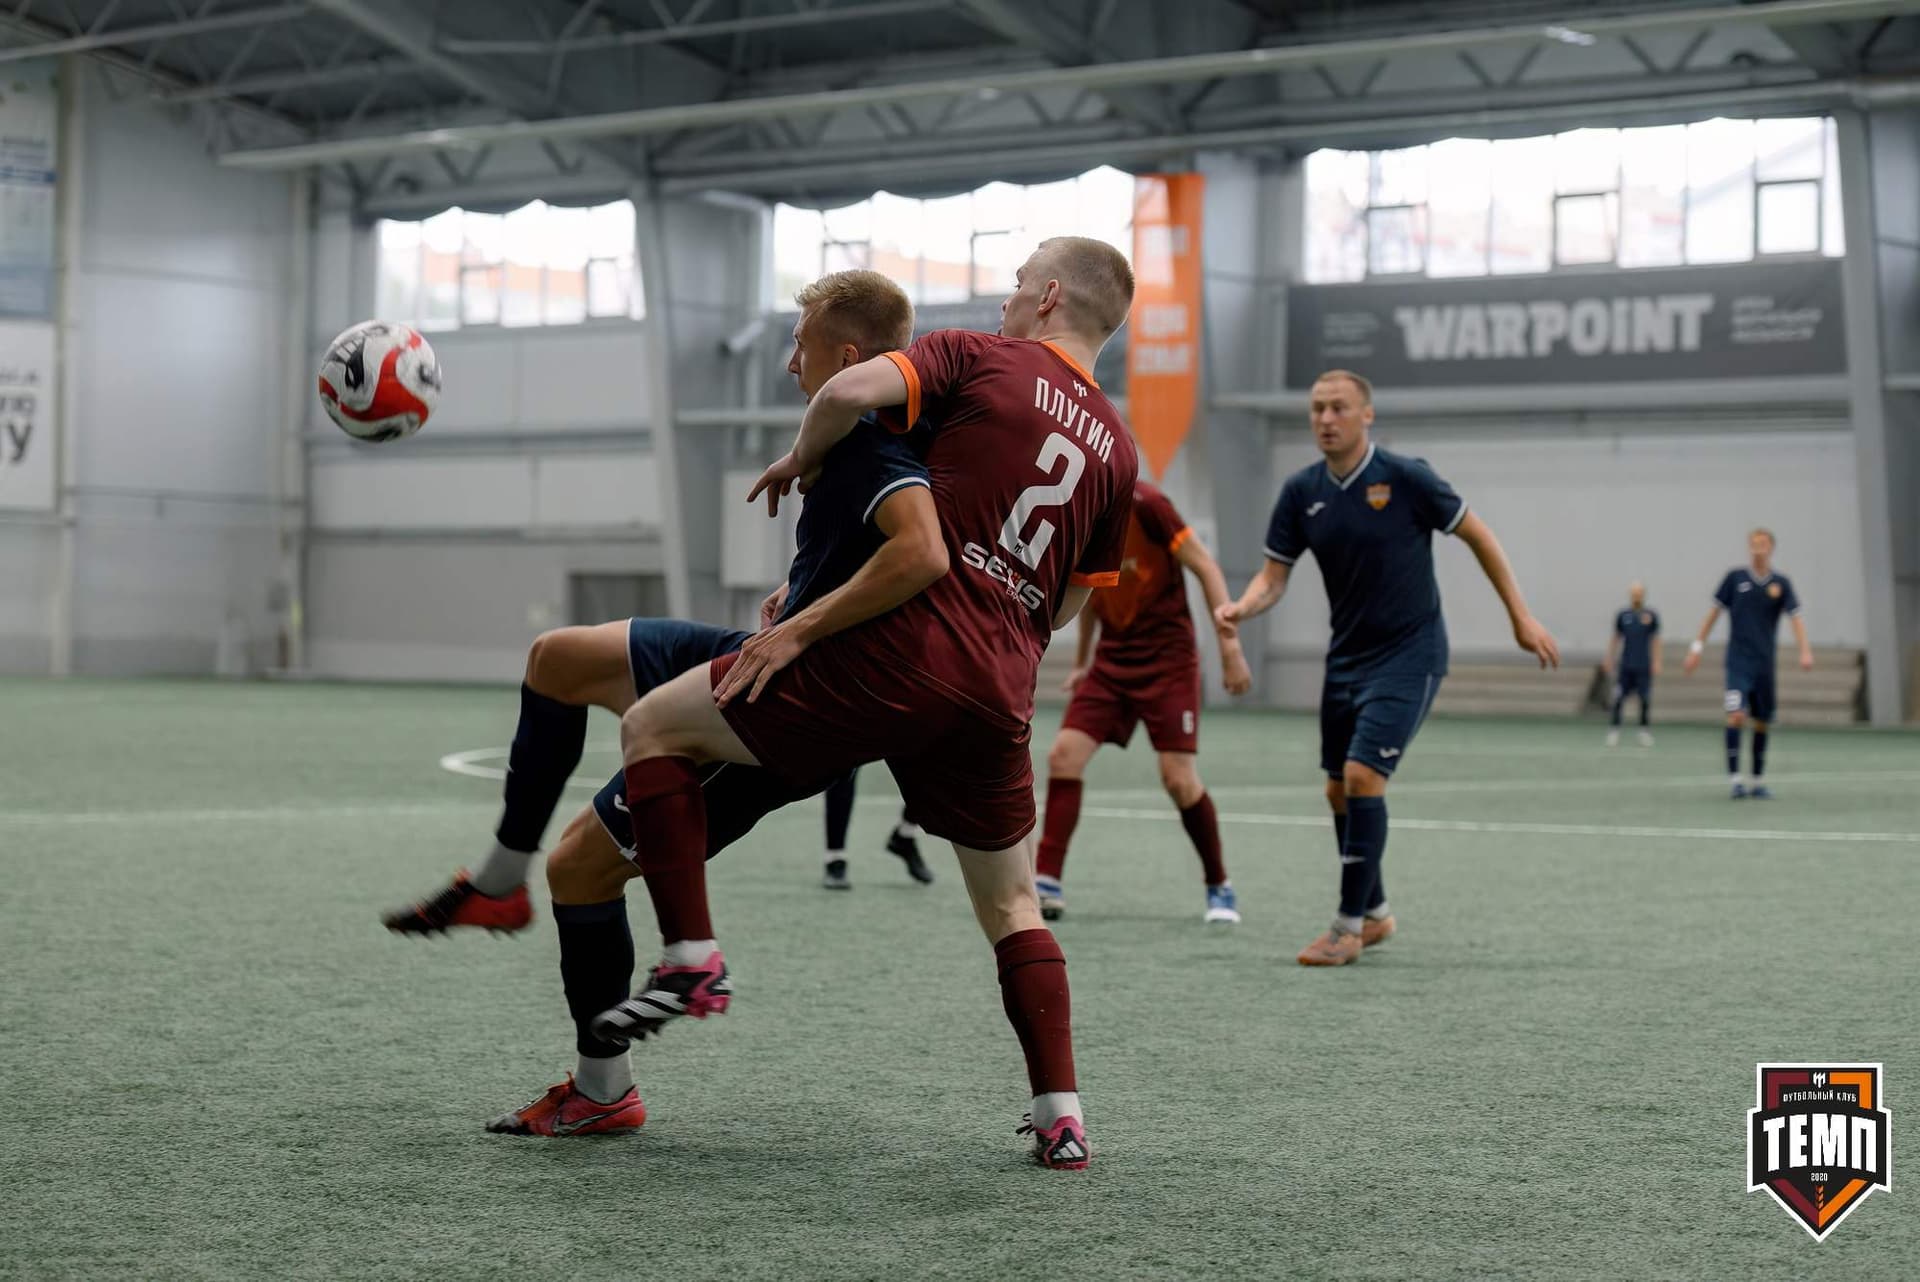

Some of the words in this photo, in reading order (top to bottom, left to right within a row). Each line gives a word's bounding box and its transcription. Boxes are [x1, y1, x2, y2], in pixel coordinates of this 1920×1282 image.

[1395, 294, 1713, 360] WARPOINT
[1034, 376, 1115, 464] ПЛУГИН
[997, 431, 1086, 571] 2
